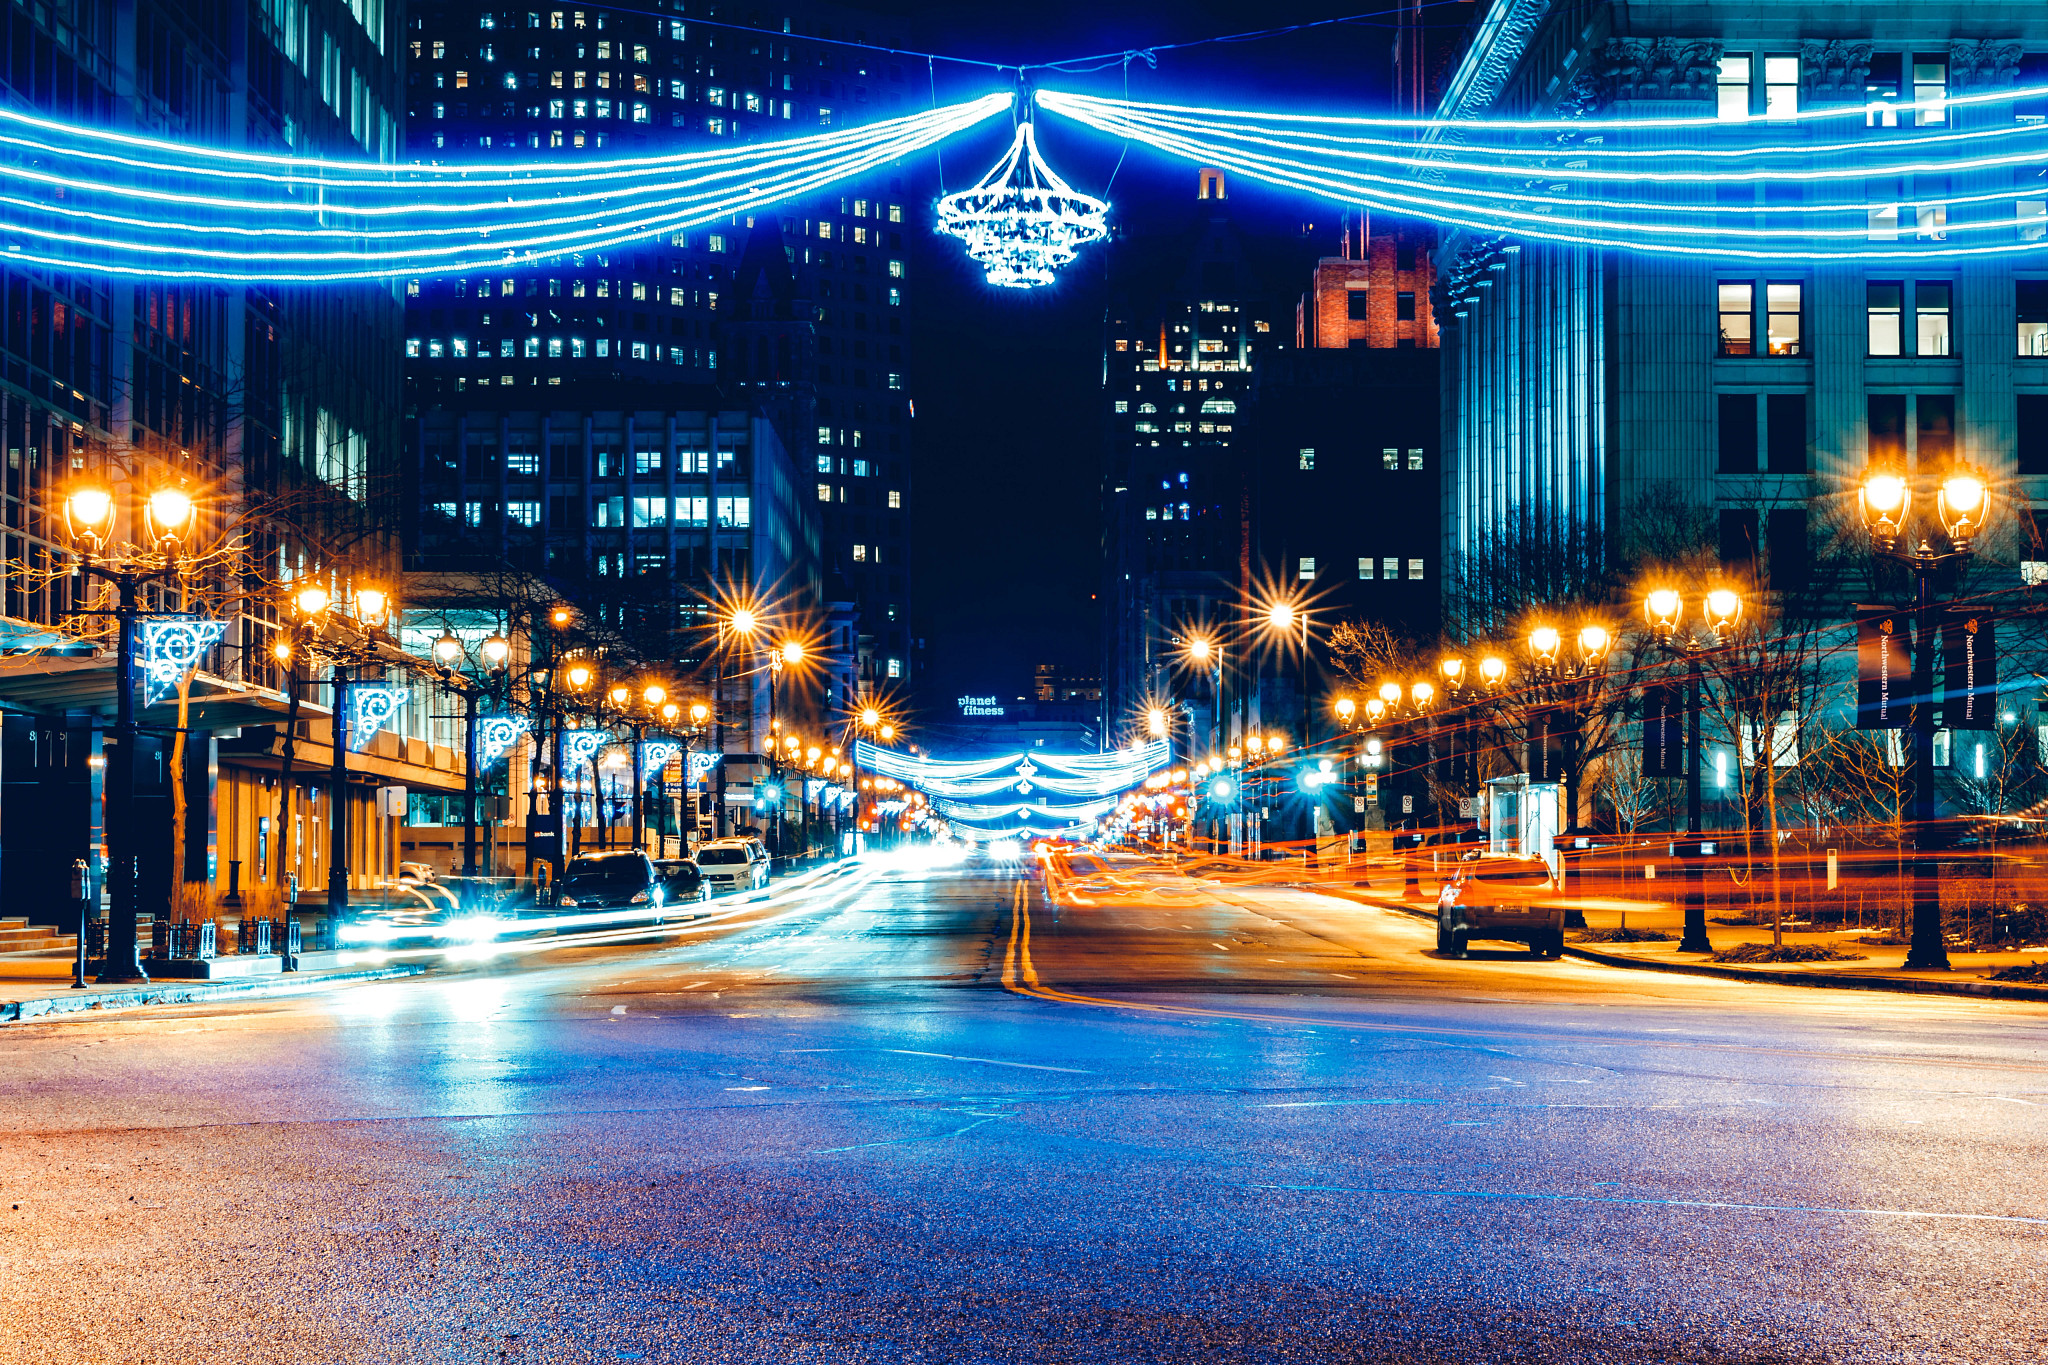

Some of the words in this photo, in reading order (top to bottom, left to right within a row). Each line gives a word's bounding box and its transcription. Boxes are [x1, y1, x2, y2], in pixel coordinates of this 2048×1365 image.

[1881, 635, 1889, 690] Northwestern
[1966, 635, 1975, 690] Northwestern
[958, 695, 996, 708] planet
[964, 705, 1004, 716] fitness
[1881, 692, 1889, 720] Mutual
[1966, 692, 1974, 720] Mutual
